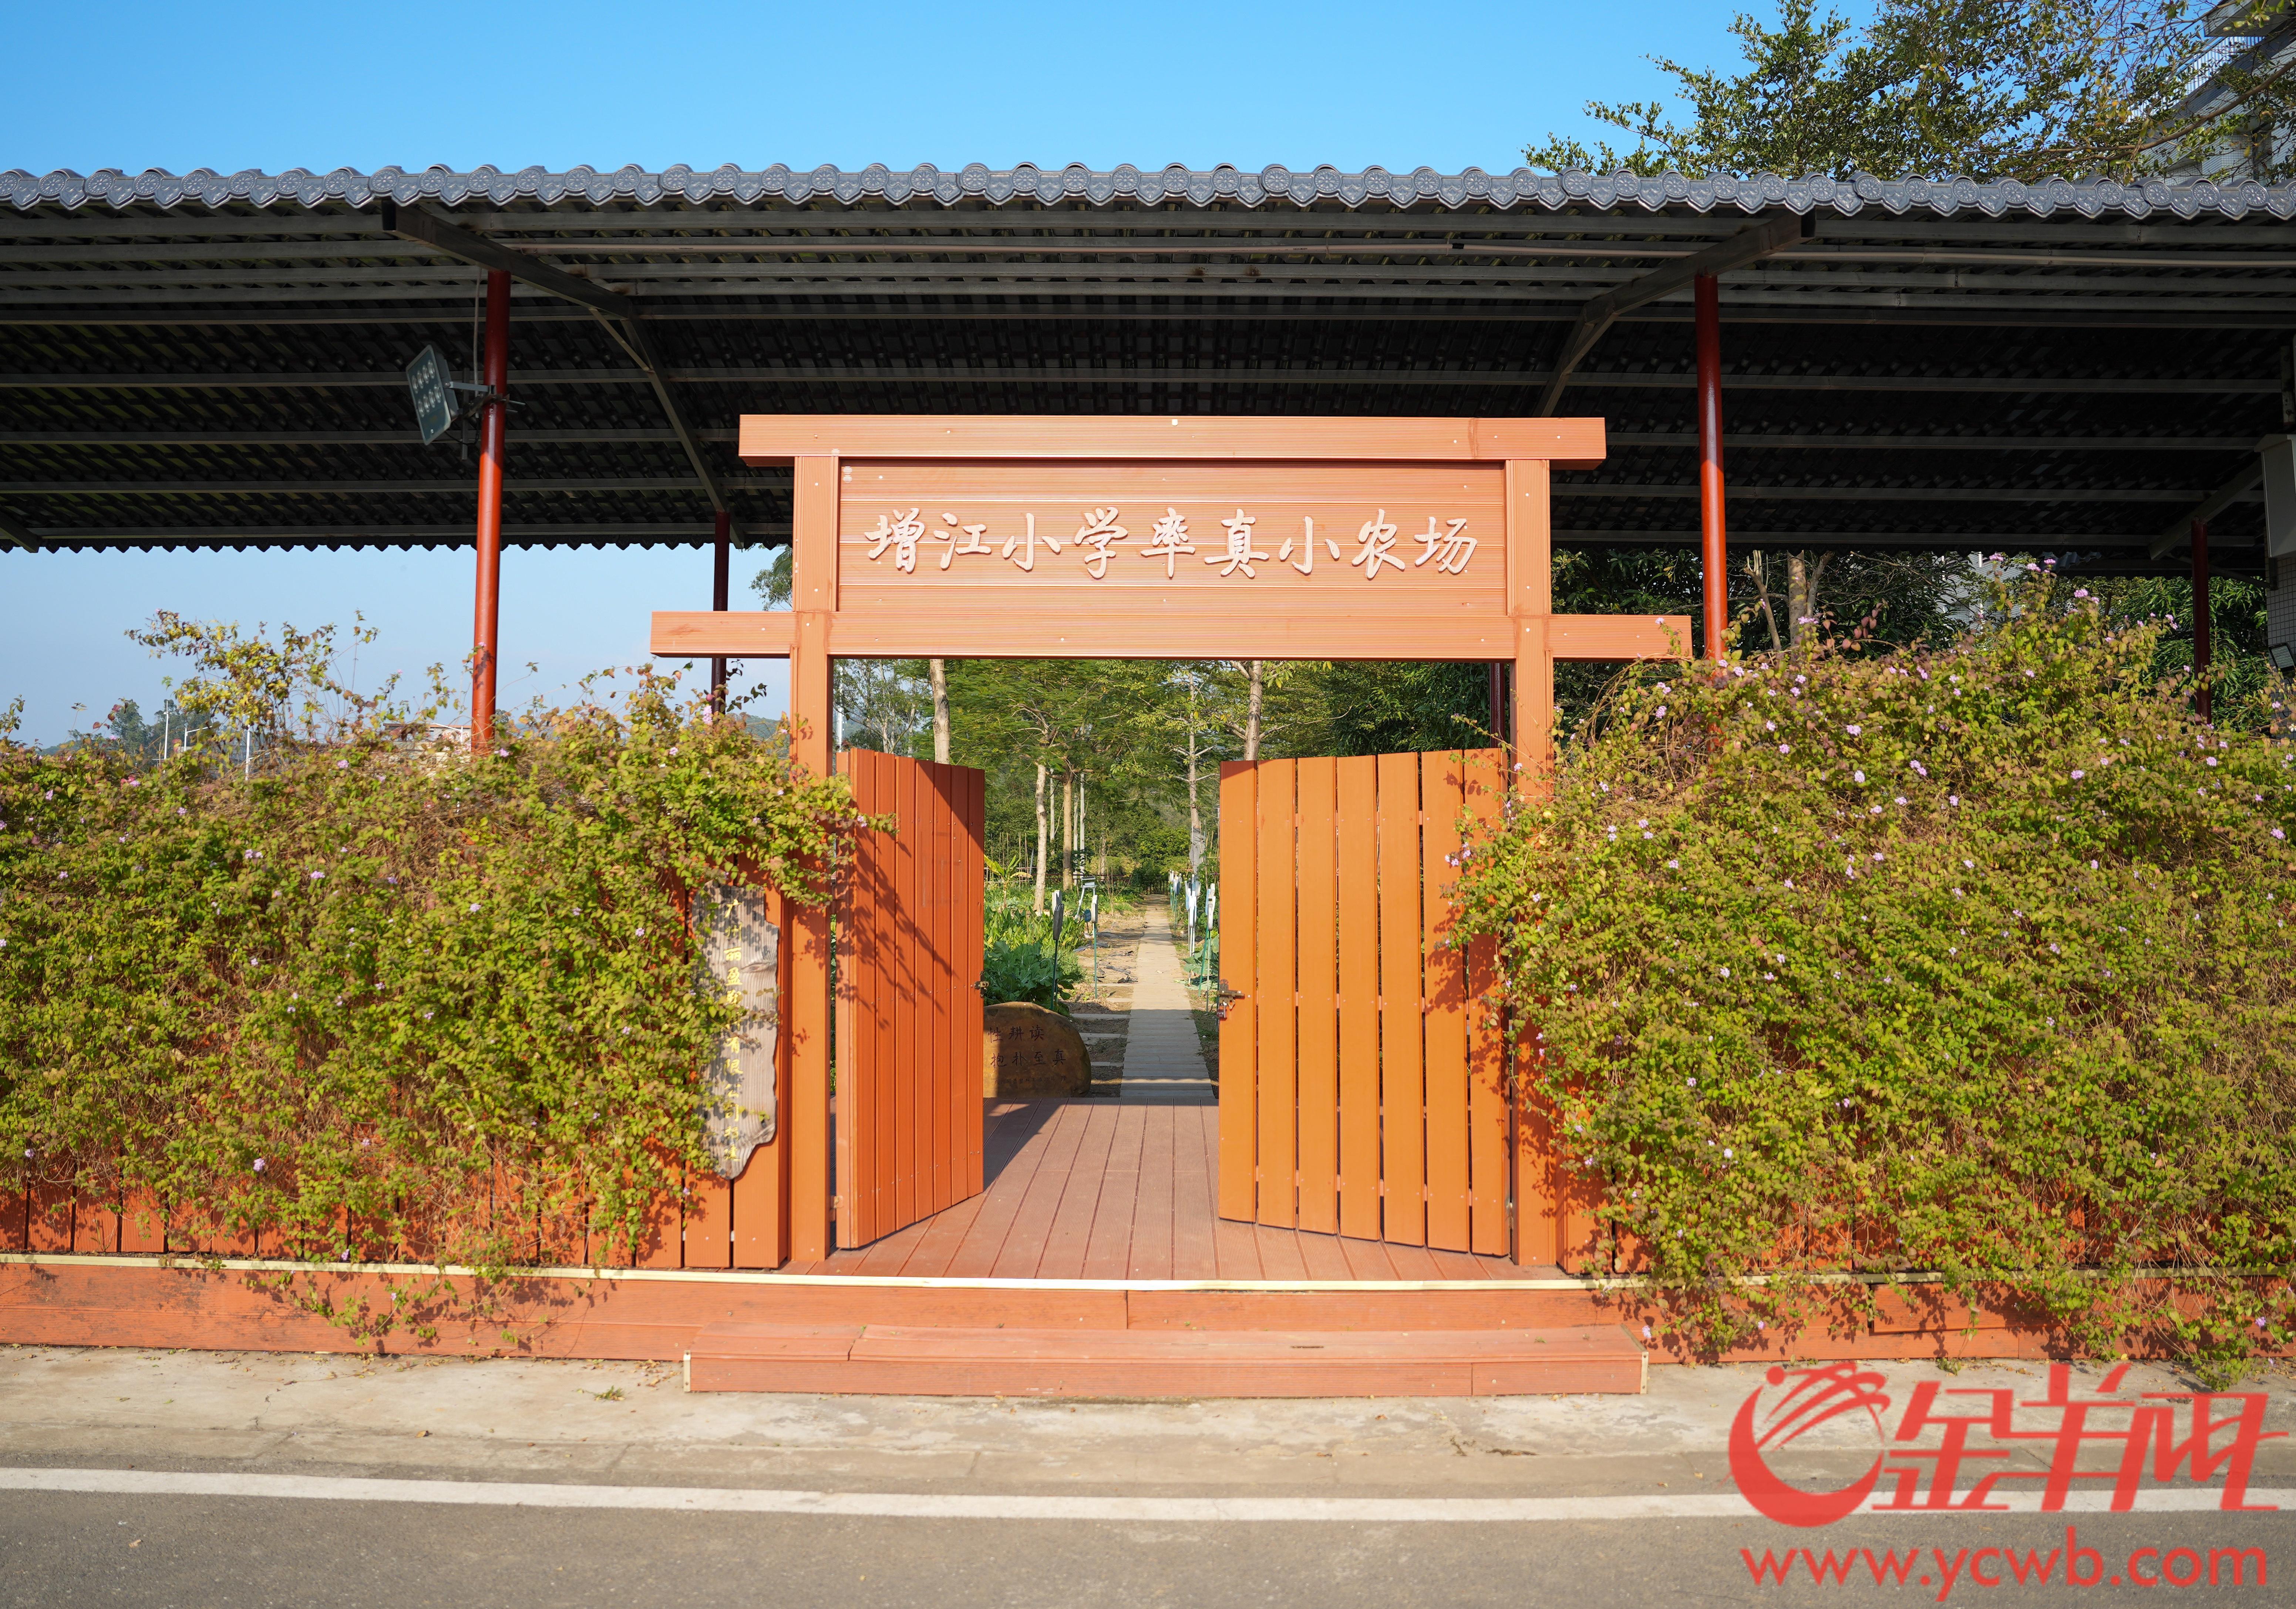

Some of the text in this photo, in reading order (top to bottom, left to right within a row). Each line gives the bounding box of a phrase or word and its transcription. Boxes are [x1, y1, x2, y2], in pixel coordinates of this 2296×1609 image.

[865, 507, 1478, 579] 增江小学率真小农场
[990, 1049, 1066, 1068] 抱朴至真
